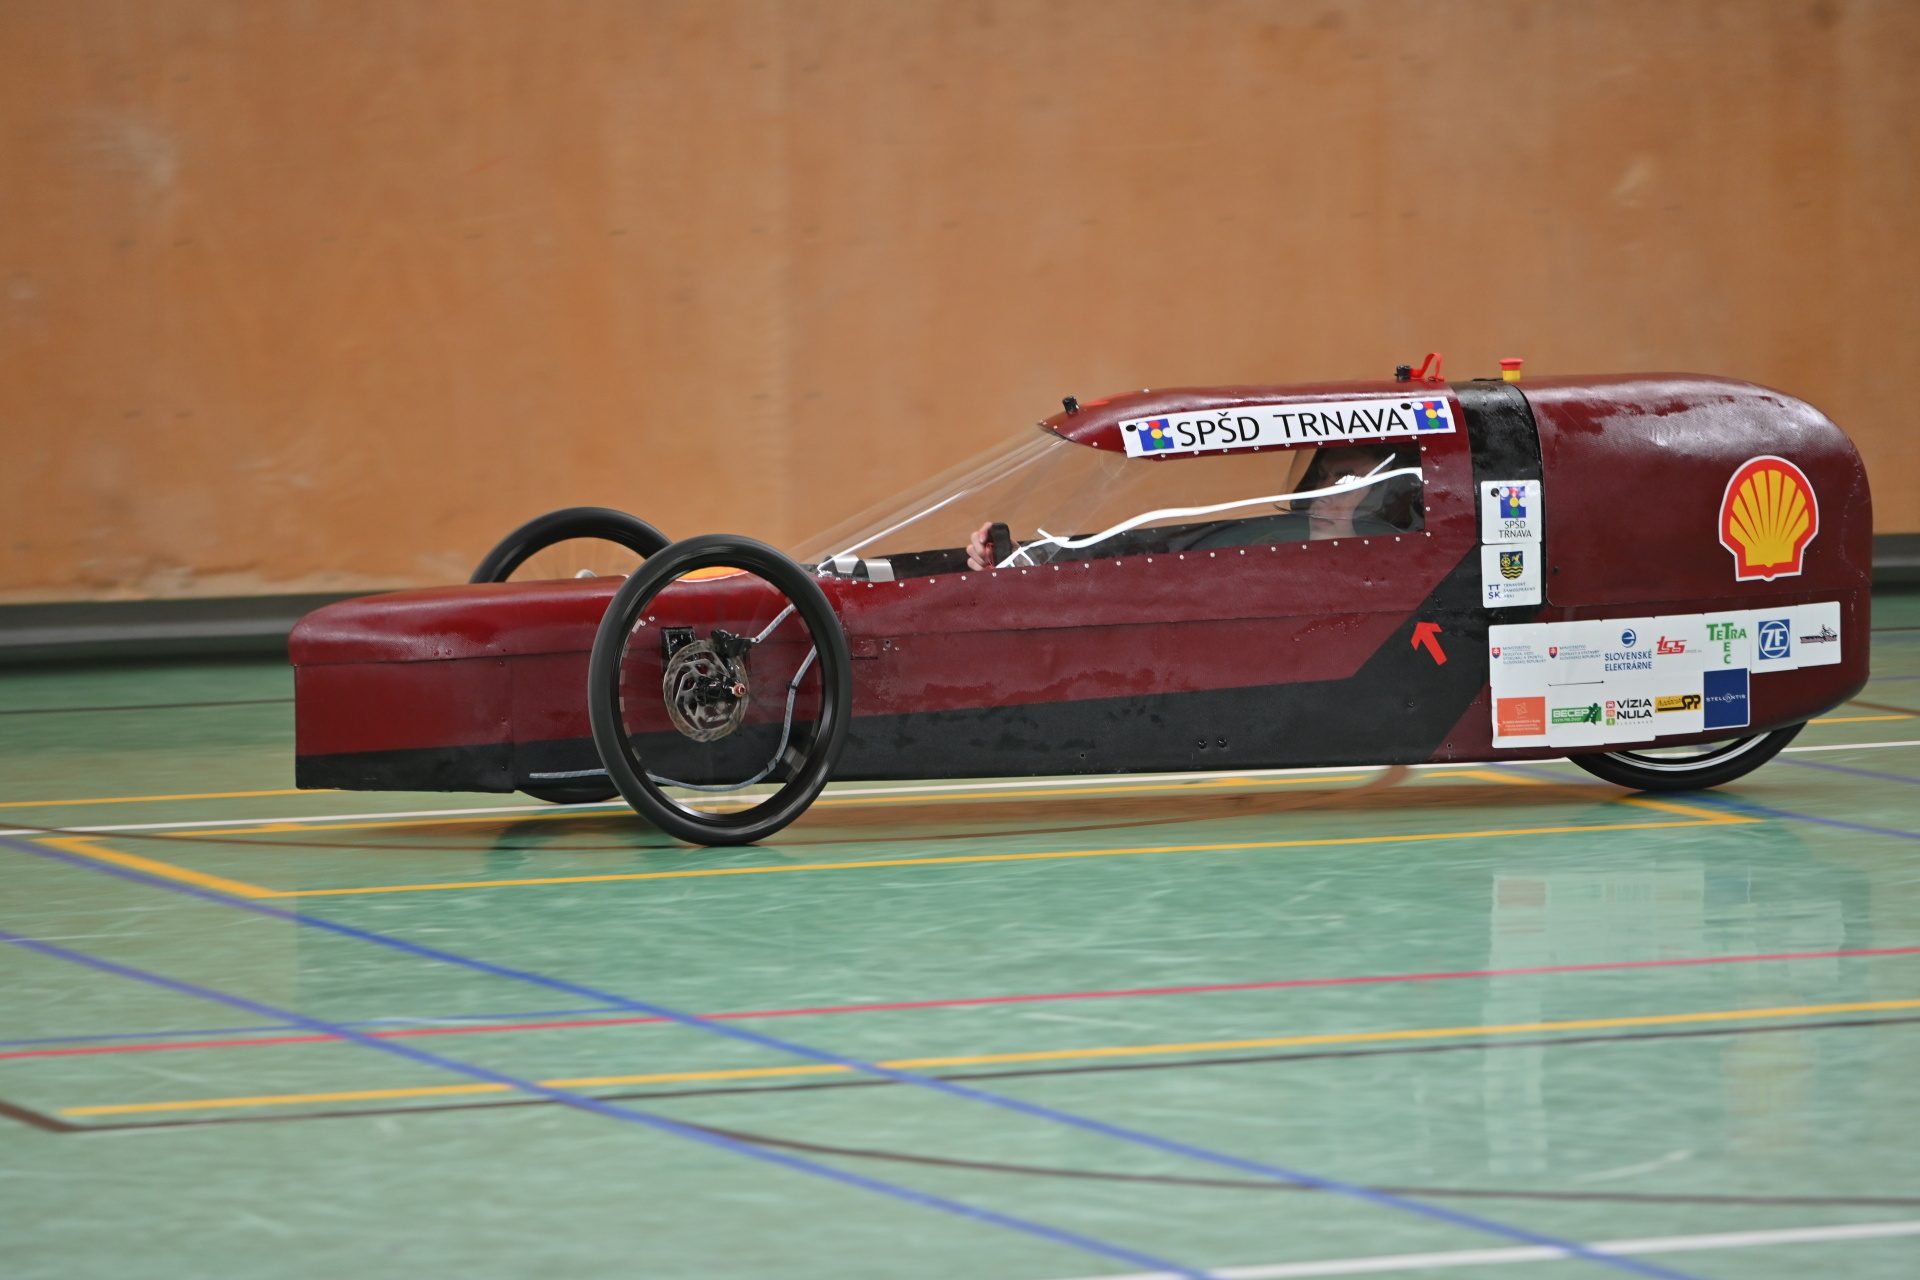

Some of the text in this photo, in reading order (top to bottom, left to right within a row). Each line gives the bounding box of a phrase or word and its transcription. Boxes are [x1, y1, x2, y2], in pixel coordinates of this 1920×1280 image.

[1176, 407, 1408, 447] SPŠD TRNAVA
[1504, 518, 1526, 529] SPŠD
[1498, 529, 1532, 539] TRNAVA
[1488, 591, 1501, 600] SK
[1763, 628, 1786, 652] ZF
[1604, 649, 1652, 661] SLOVENSKÉ
[1604, 661, 1652, 672] ELEKTRÁRNE
[1706, 692, 1746, 703] STELLANTIS
[1616, 698, 1653, 709] VÍZIA
[1616, 709, 1653, 720] NULA
